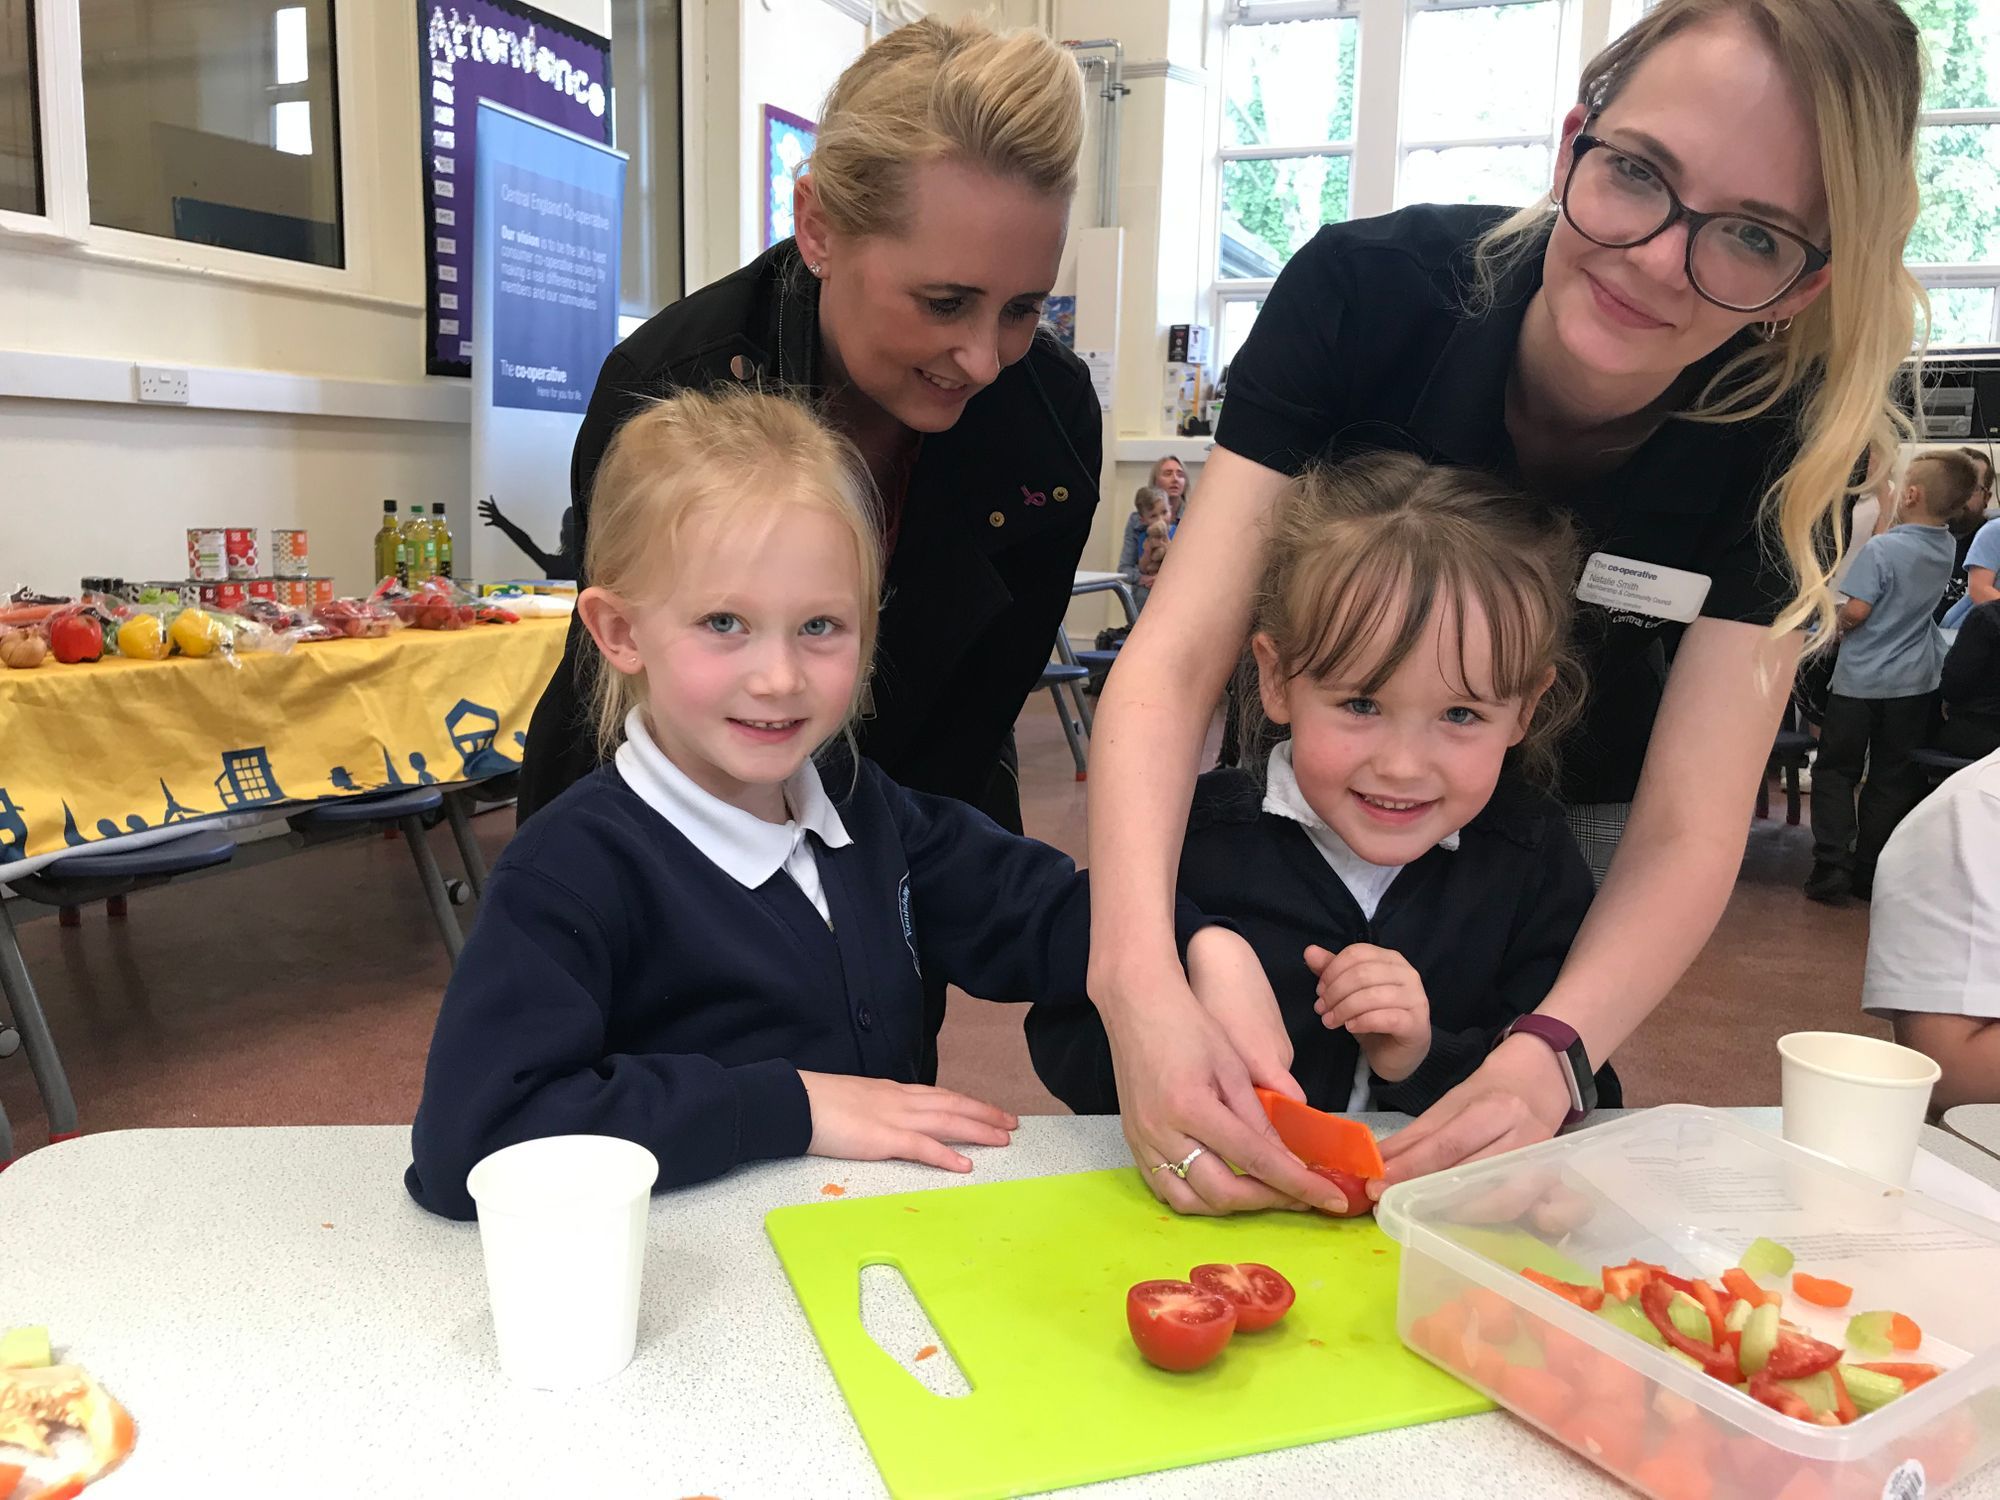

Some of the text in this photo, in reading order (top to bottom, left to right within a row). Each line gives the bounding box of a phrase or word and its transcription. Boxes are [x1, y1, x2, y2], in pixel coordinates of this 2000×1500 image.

[501, 184, 530, 207] Central
[531, 192, 562, 216] England
[501, 225, 515, 240] Our
[516, 229, 540, 248] vision
[532, 270, 545, 283] real
[546, 271, 577, 290] difference
[532, 287, 546, 300] and
[500, 359, 568, 383] The co-operative
[1592, 559, 1658, 581] The co-operative
[1588, 573, 1639, 592] Natalie Smith
[1623, 590, 1652, 602] Community
